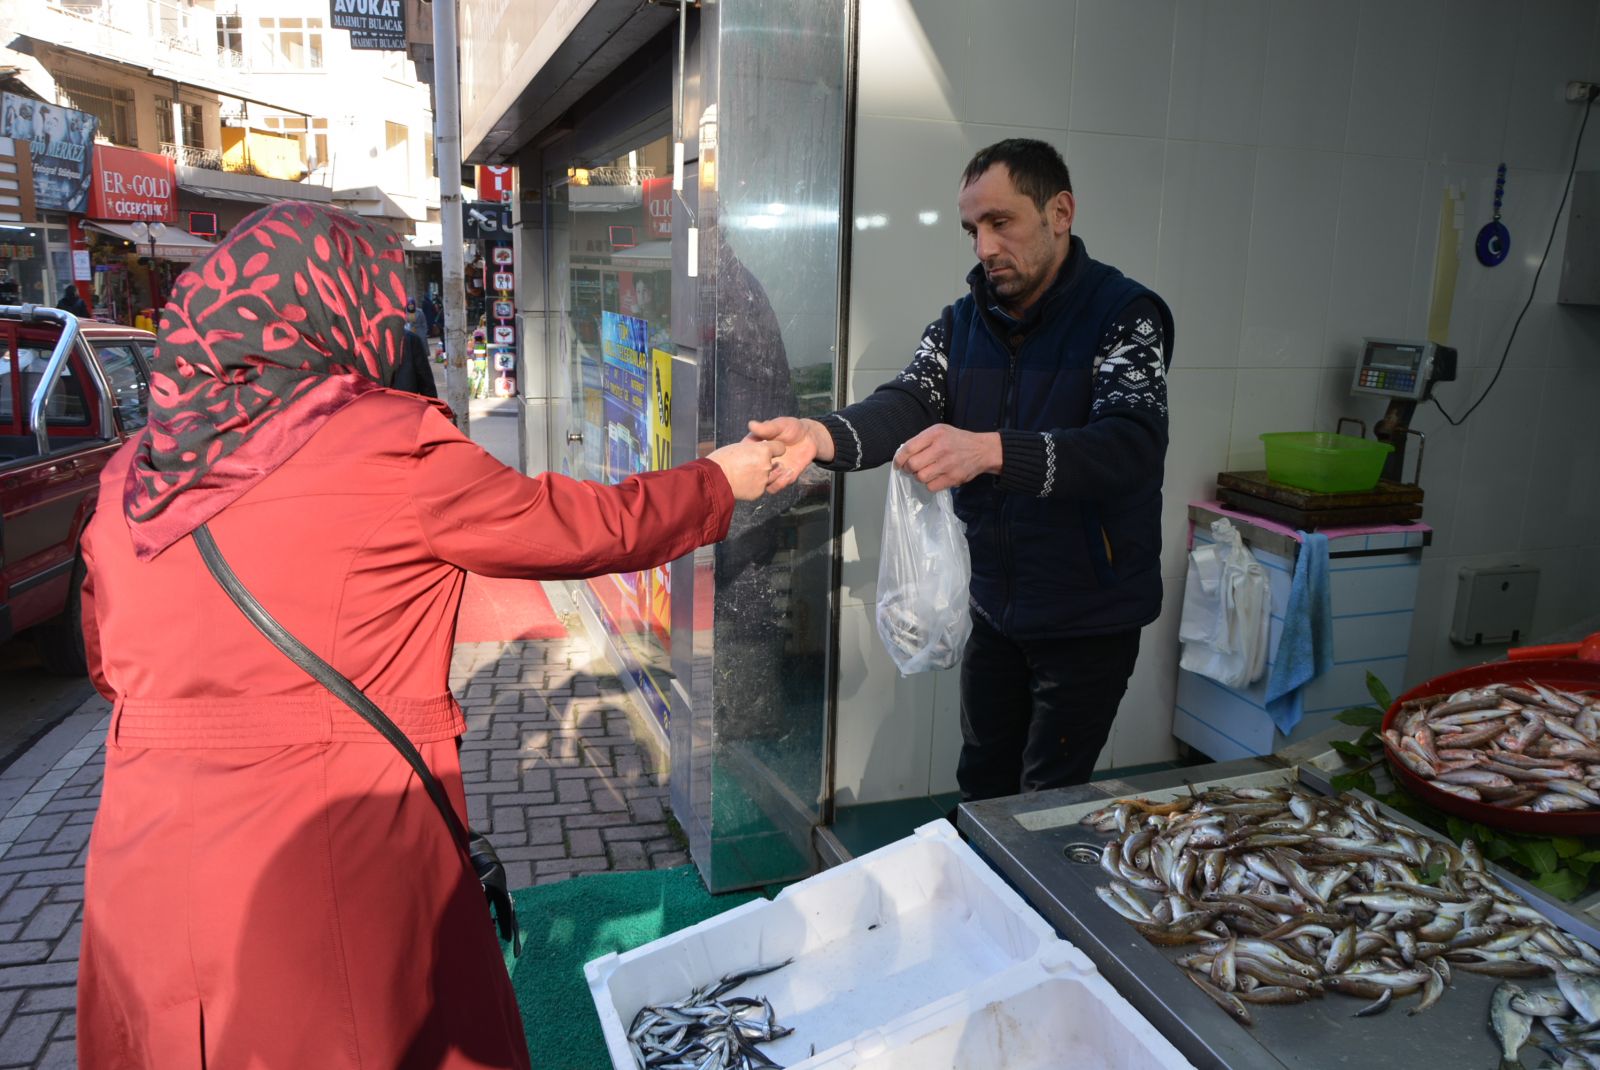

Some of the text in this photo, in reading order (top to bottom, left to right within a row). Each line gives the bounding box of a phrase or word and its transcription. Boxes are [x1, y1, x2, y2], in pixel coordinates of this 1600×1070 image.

[334, 0, 401, 17] AVUKAT
[334, 15, 403, 32] MAHMUT BULACAK
